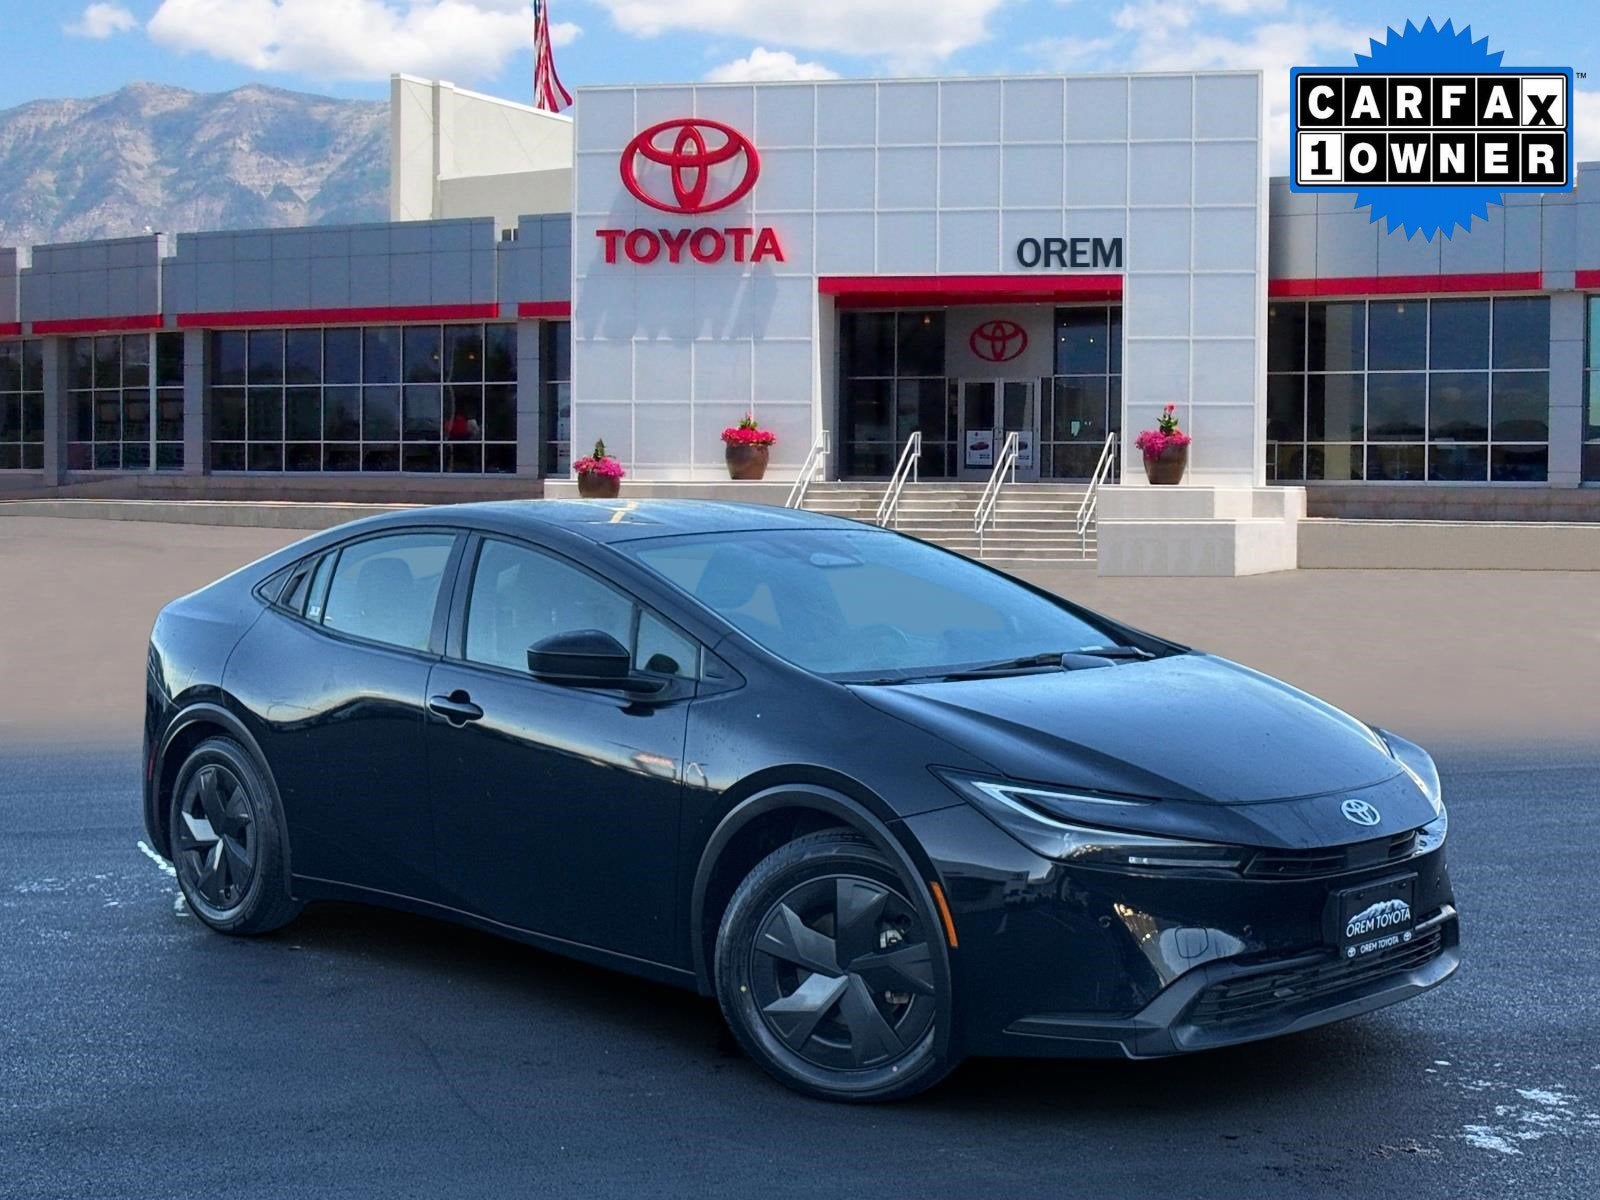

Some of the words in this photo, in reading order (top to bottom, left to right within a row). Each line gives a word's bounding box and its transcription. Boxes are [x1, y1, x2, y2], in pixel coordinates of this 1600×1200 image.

[596, 227, 784, 264] TOYOTA
[1017, 237, 1123, 268] OREM
[1346, 917, 1374, 938] OREM
[1376, 908, 1411, 929] TOYOTA
[1360, 941, 1377, 954] OREM
[1378, 935, 1399, 949] TOYOTA
